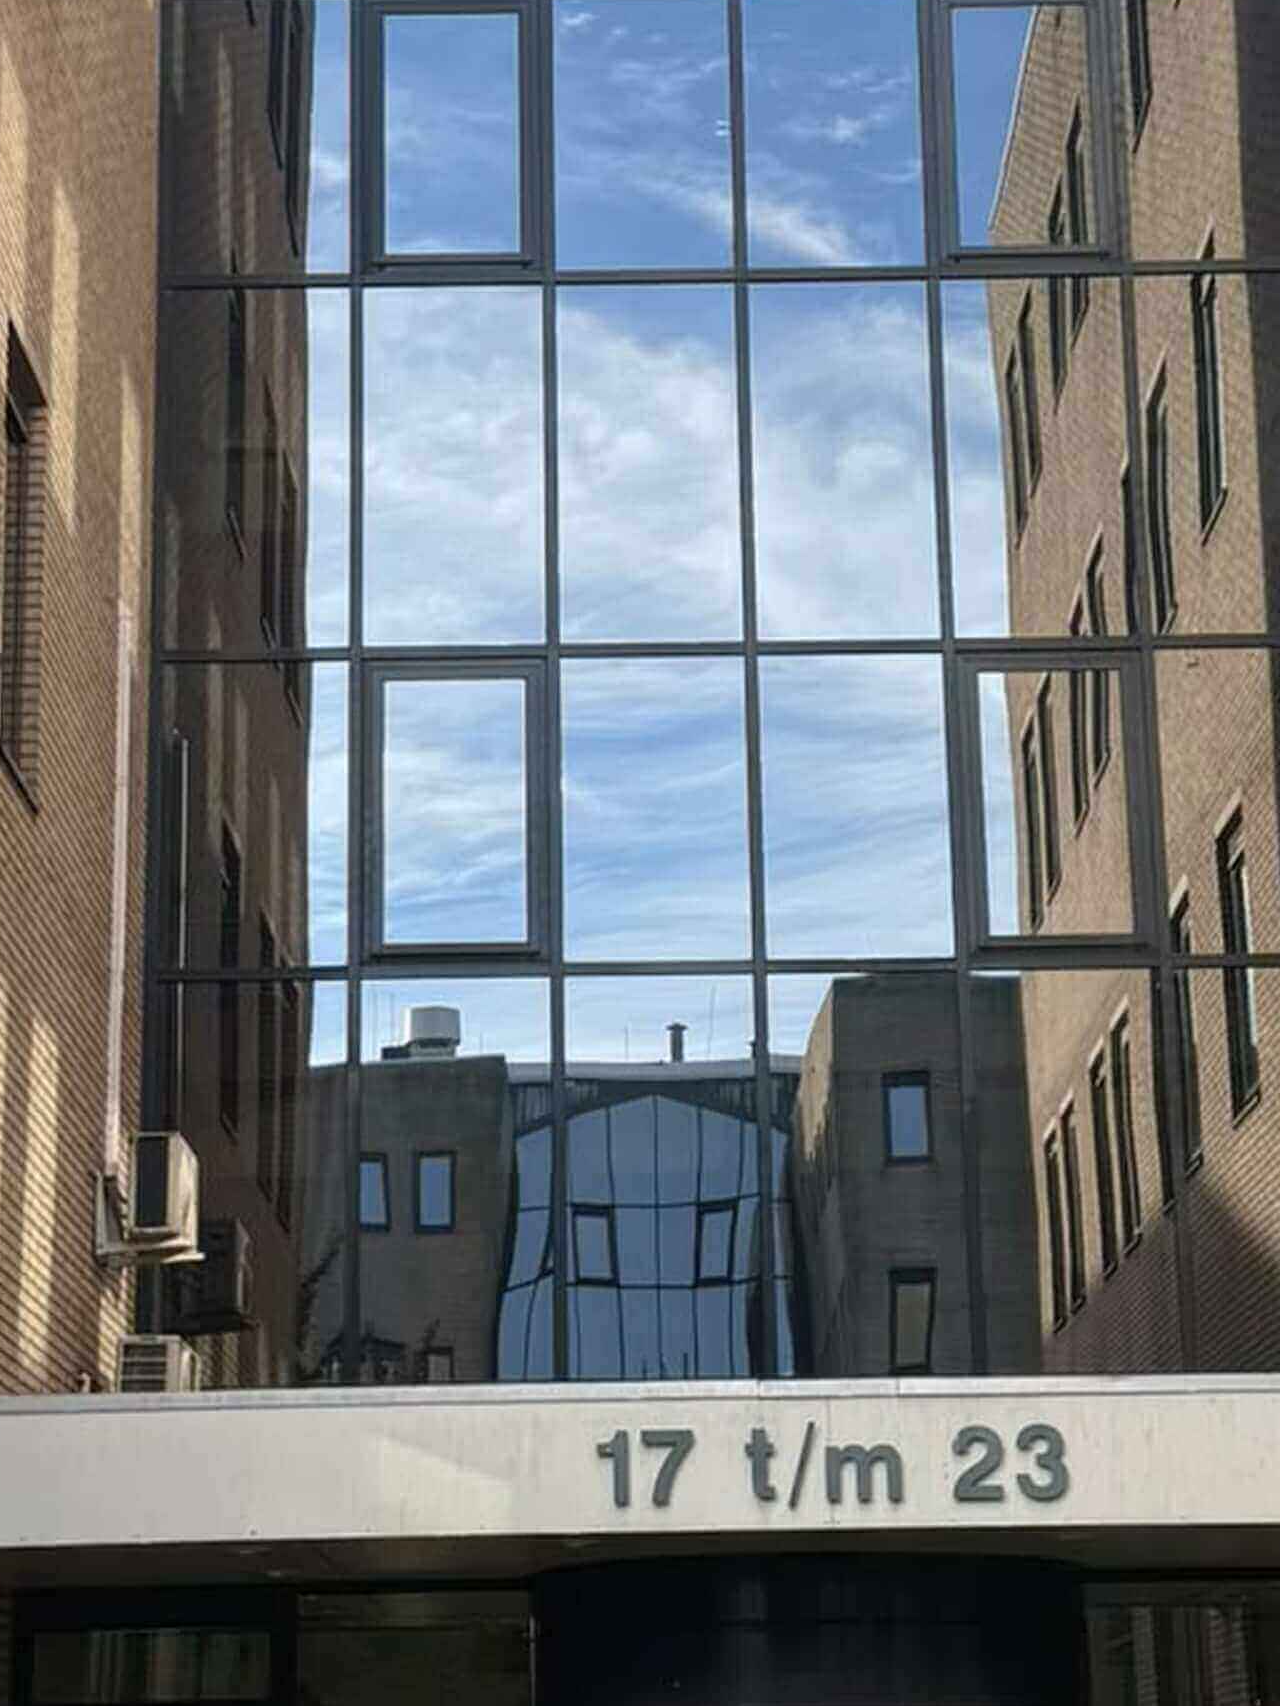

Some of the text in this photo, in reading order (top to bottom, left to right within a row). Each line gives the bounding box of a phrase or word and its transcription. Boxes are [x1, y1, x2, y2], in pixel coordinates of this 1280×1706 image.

[596, 1420, 1071, 1511] 17 t/m 23
